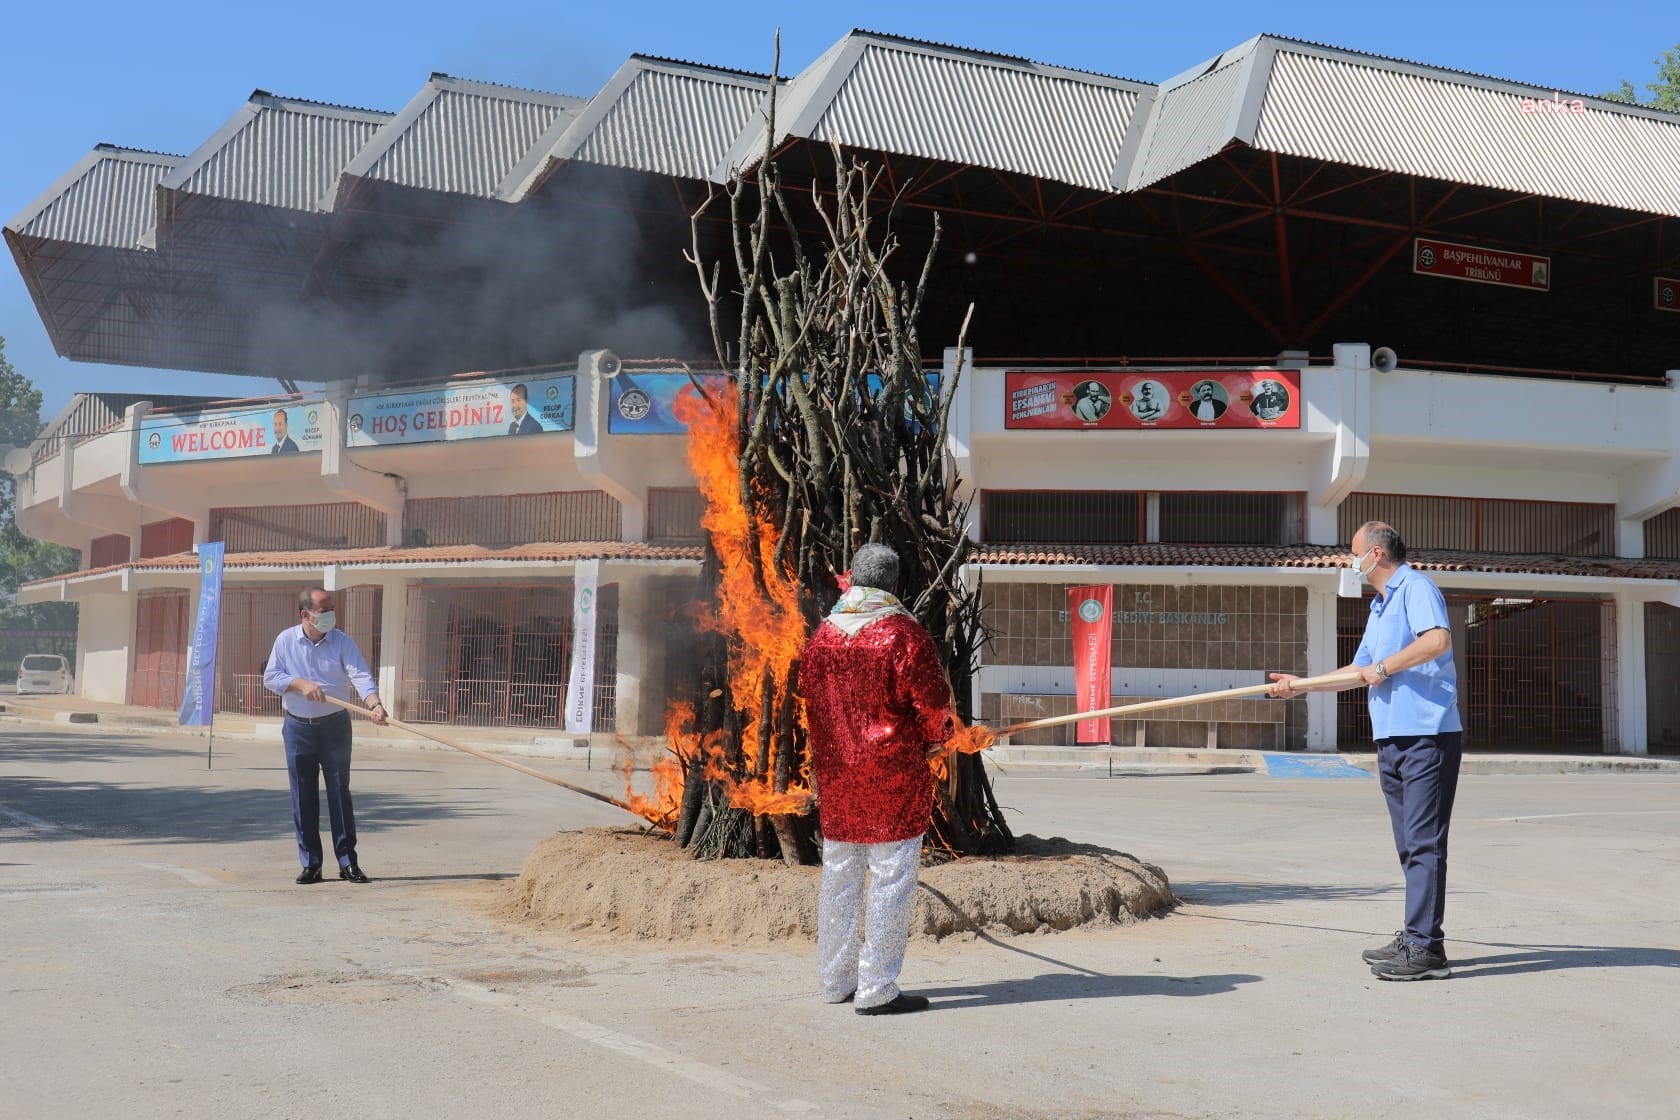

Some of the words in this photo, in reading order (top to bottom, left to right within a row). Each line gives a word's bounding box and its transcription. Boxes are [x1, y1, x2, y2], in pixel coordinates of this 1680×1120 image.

[1443, 249, 1522, 270] BAŞPEHLİVANLAR
[1464, 265, 1502, 281] TRİBÜNÜ
[371, 414, 408, 437] HOŞ
[413, 401, 504, 431] GELDİNİZ
[171, 427, 267, 454] WELCOME
[1111, 608, 1155, 624] ELEDİYE
